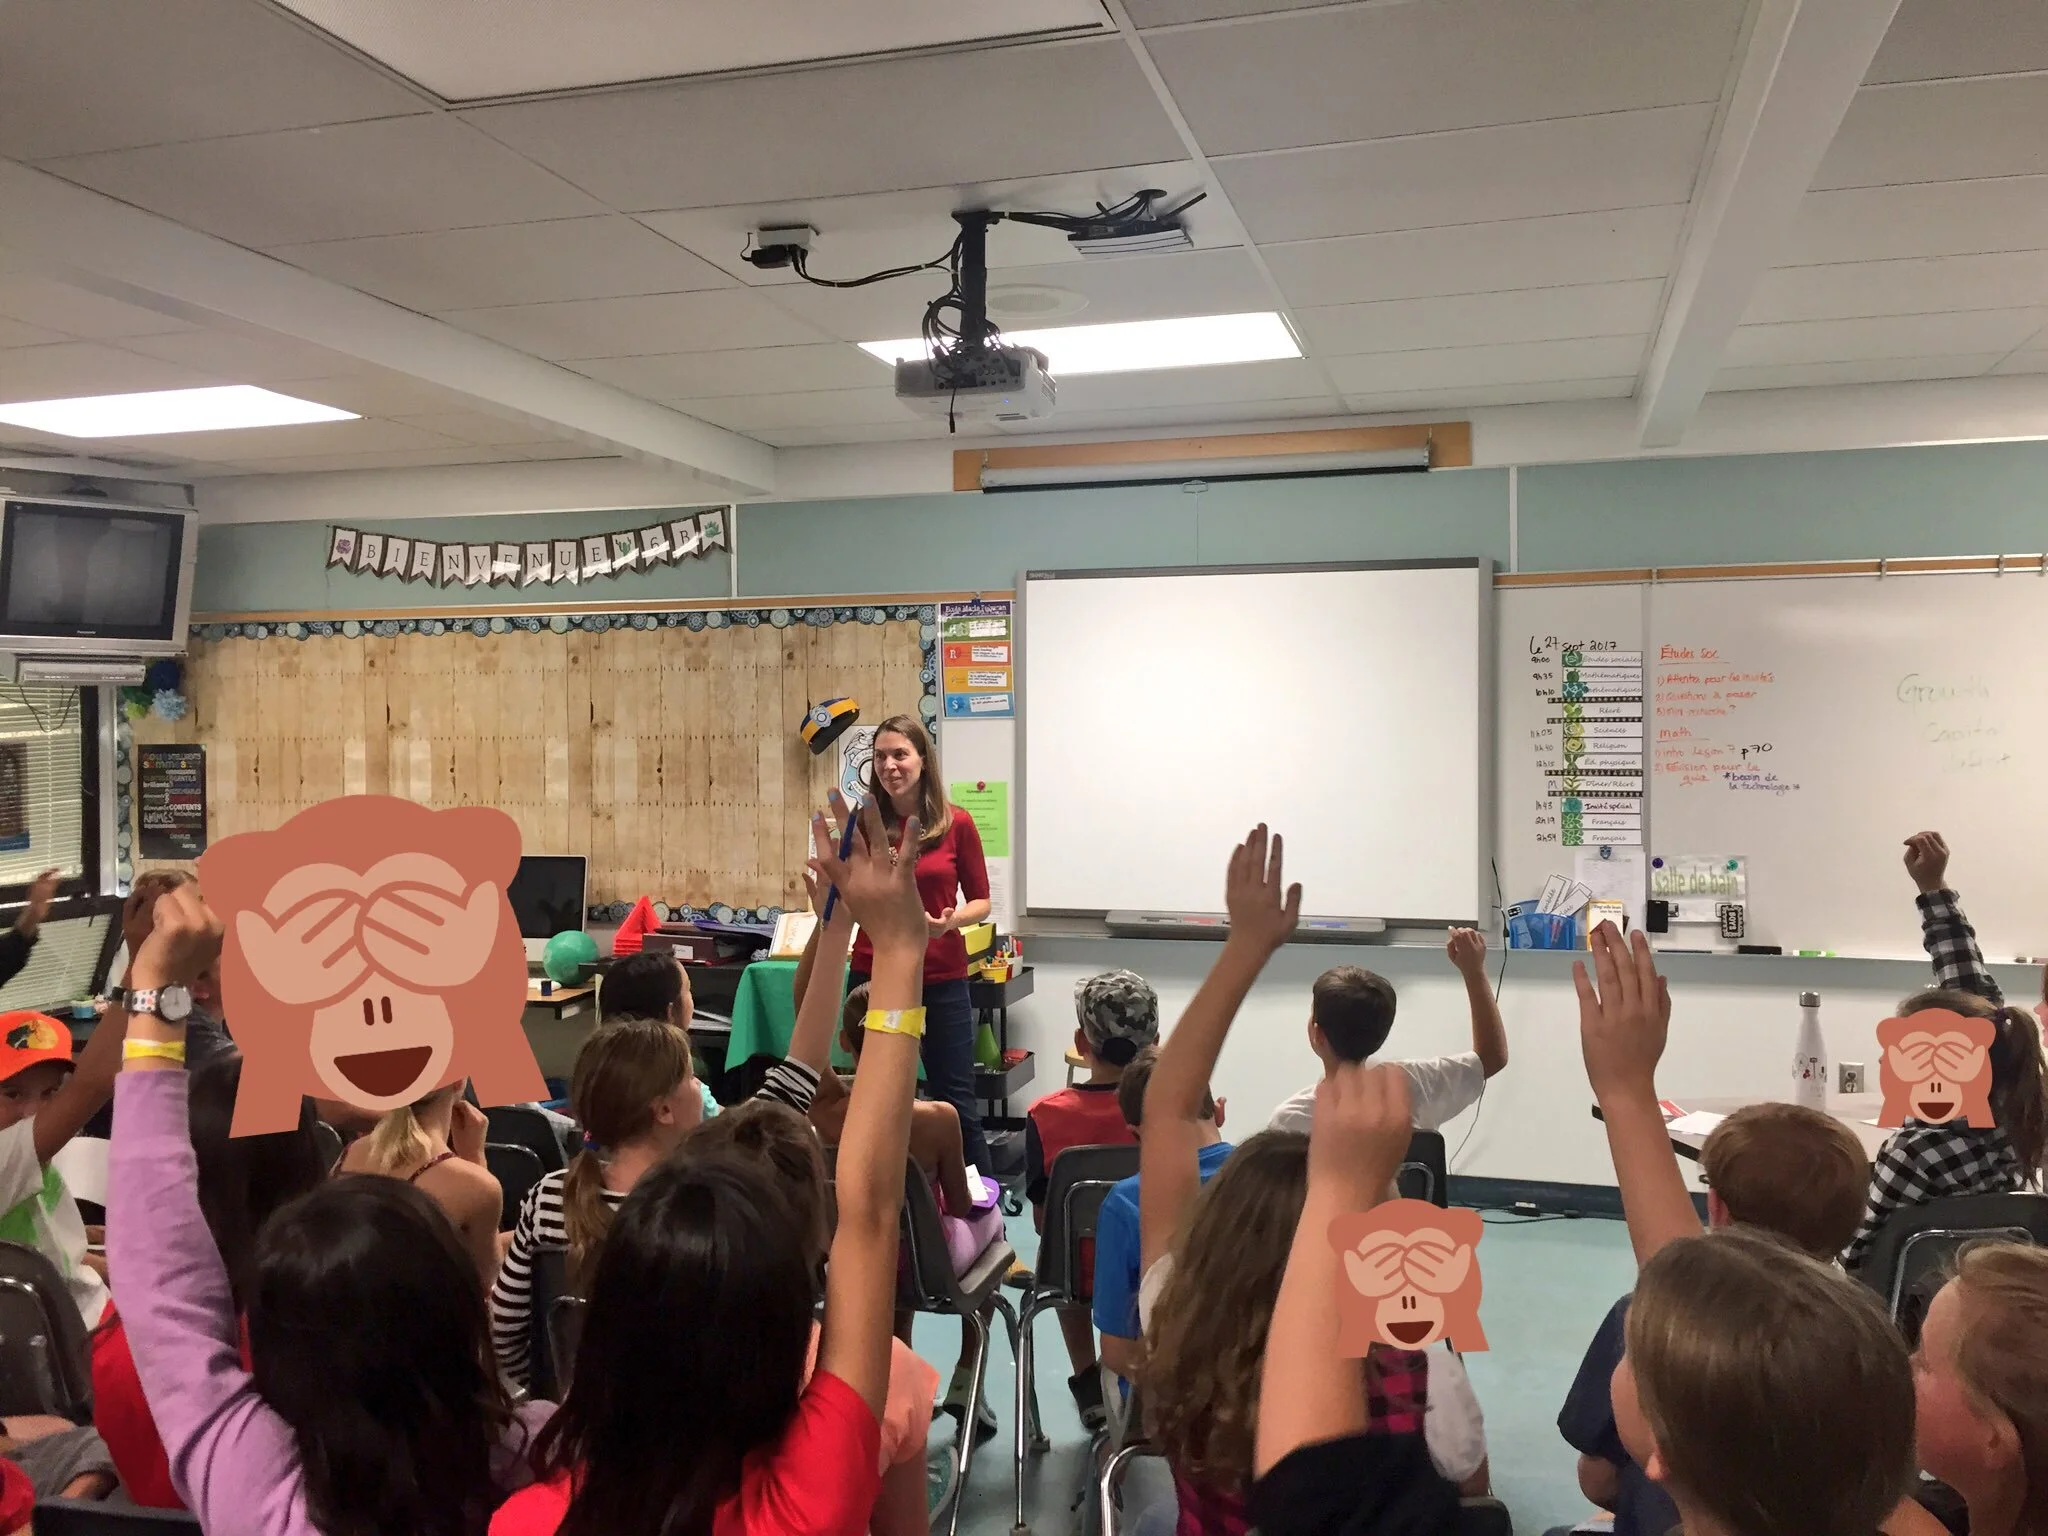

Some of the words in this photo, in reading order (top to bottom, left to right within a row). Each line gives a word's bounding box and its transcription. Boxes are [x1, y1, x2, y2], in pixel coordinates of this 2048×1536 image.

[366, 543, 602, 571] BIENVENUE
[650, 529, 690, 549] 6B
[1544, 636, 1559, 651] 27
[1562, 641, 1585, 654] sept
[1589, 640, 1617, 651] 2017
[1660, 644, 1695, 659] Études
[1532, 672, 1554, 680] 9h35
[1535, 688, 1556, 697] 10h10
[1593, 726, 1628, 735] Sciences
[1659, 727, 1692, 738] Math
[1713, 763, 1741, 774] pour
[169, 803, 202, 811] CONTENTS
[1591, 819, 1627, 828] Français
[1592, 834, 1627, 843] Français
[1655, 865, 1686, 897] Salle
[1690, 865, 1707, 894] de
[1710, 865, 1739, 897] bain
[1728, 911, 1737, 931] BOYS
